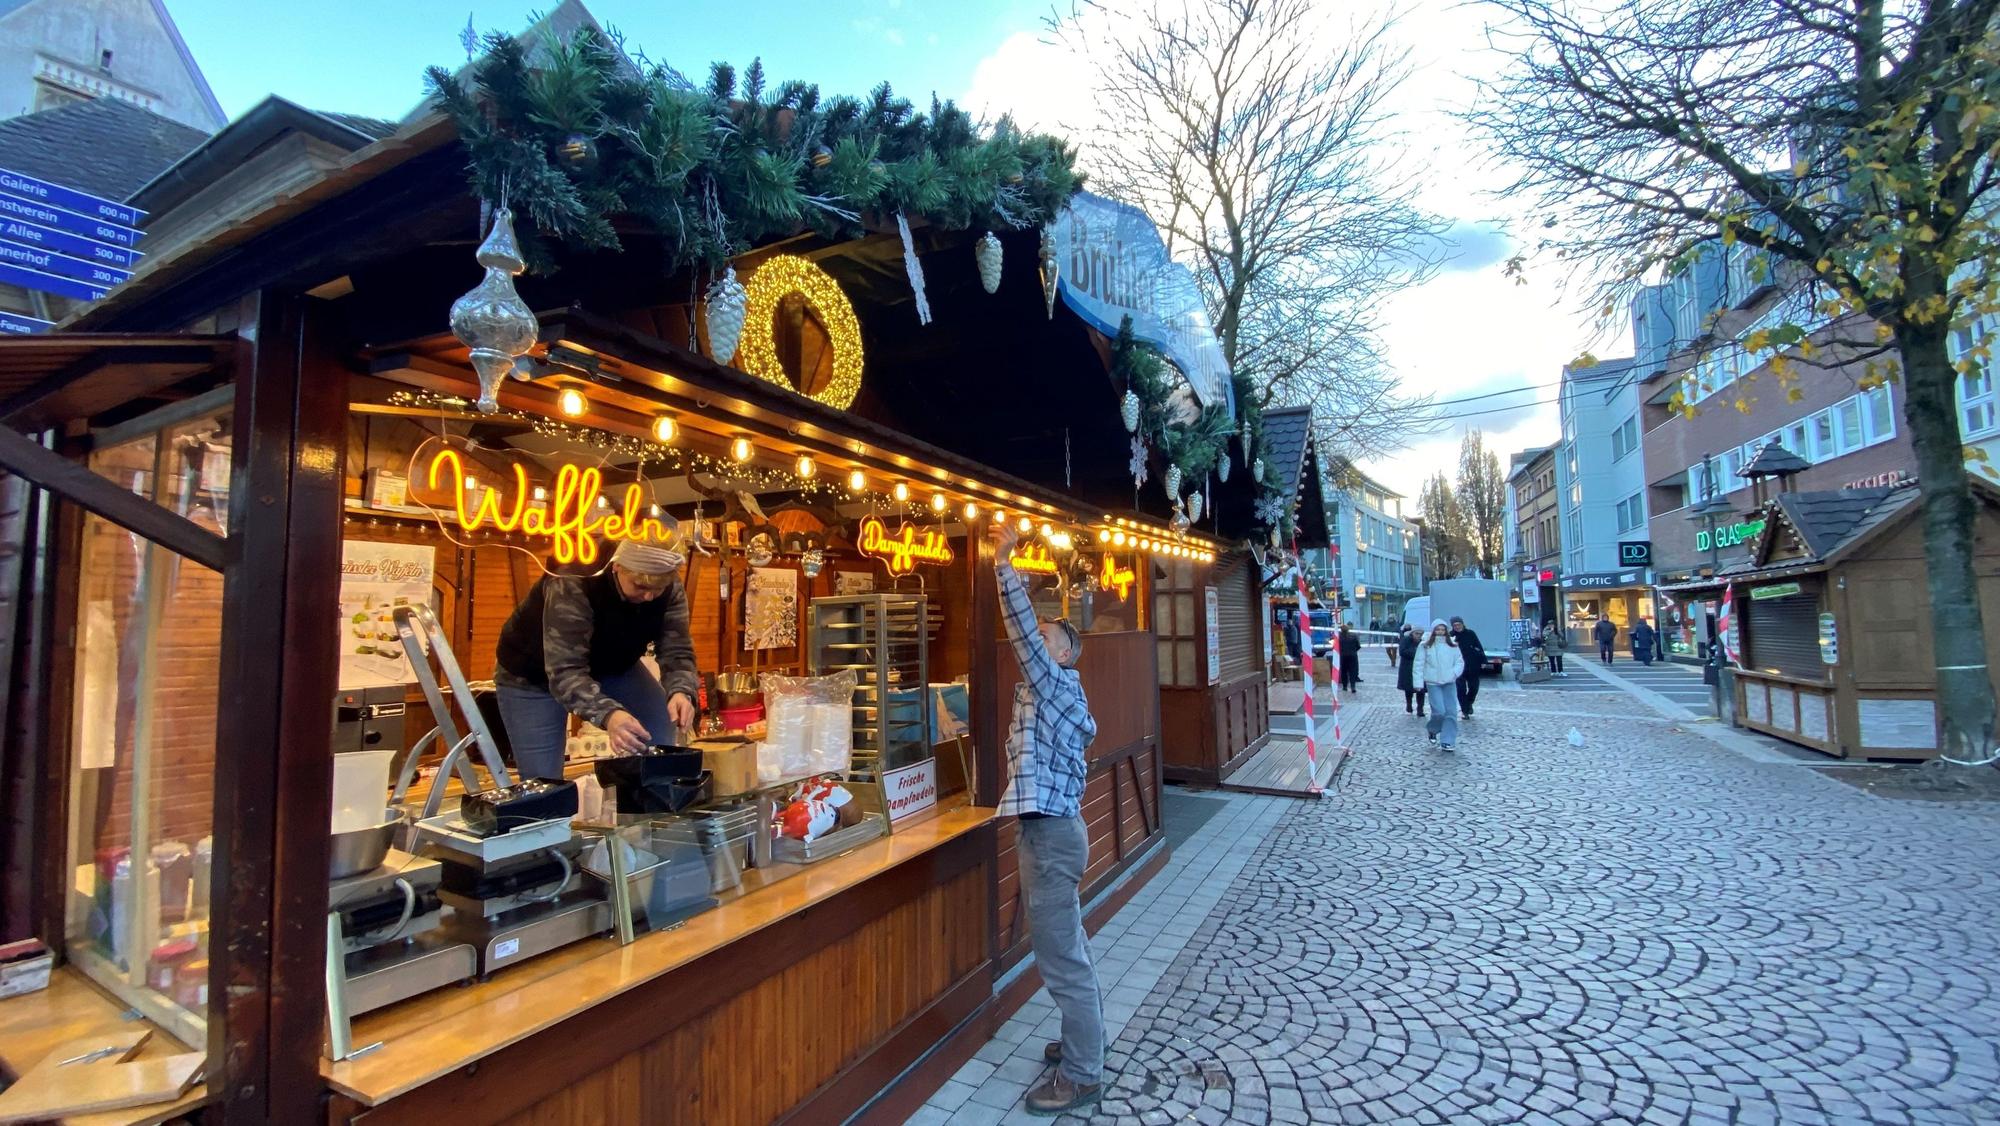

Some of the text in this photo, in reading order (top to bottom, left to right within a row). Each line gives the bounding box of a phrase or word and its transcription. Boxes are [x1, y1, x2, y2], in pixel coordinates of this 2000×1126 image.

[0, 175, 129, 221] Galerie 600 m
[7, 224, 42, 240] Allee
[95, 248, 113, 259] 500
[115, 254, 125, 262] m
[96, 227, 115, 239] 600
[117, 234, 127, 242] m
[93, 270, 111, 281] 300
[429, 449, 672, 565] Waffeln
[864, 520, 952, 571] Dampfnudeln
[1623, 545, 1647, 558] DO
[379, 558, 424, 580] Waffeln
[1580, 576, 1612, 586] OPTIC
[898, 771, 925, 790] Frische
